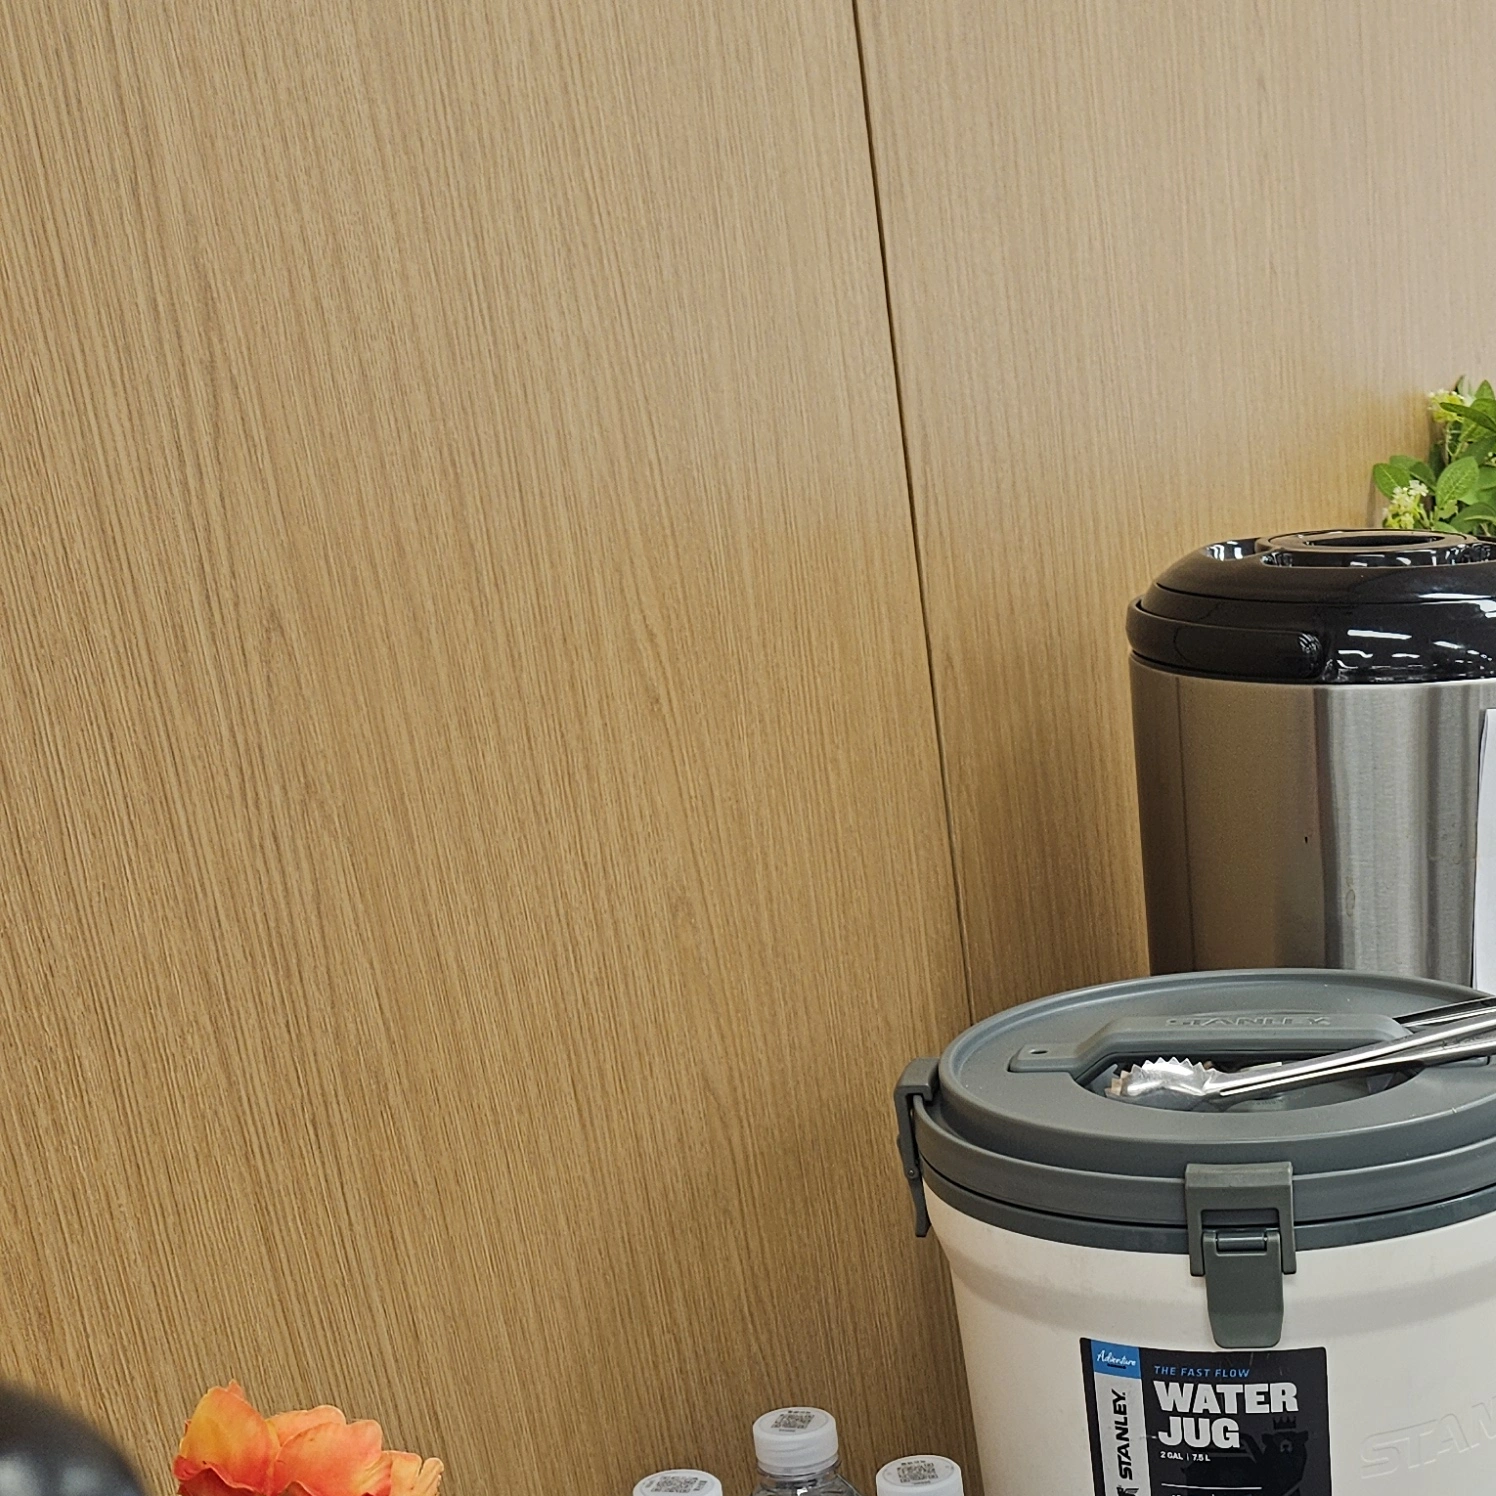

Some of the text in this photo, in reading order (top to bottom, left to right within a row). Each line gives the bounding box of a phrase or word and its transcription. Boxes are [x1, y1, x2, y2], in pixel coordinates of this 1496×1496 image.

[1096, 1349, 1137, 1367] Adventure
[1154, 1365, 1251, 1378] THE FAST FLOW
[1153, 1381, 1299, 1414] WATER
[1110, 1389, 1134, 1481] STANLEY
[1157, 1416, 1240, 1449] JUG
[1160, 1450, 1184, 1461] 2 GAL
[1205, 1454, 1211, 1462] L
